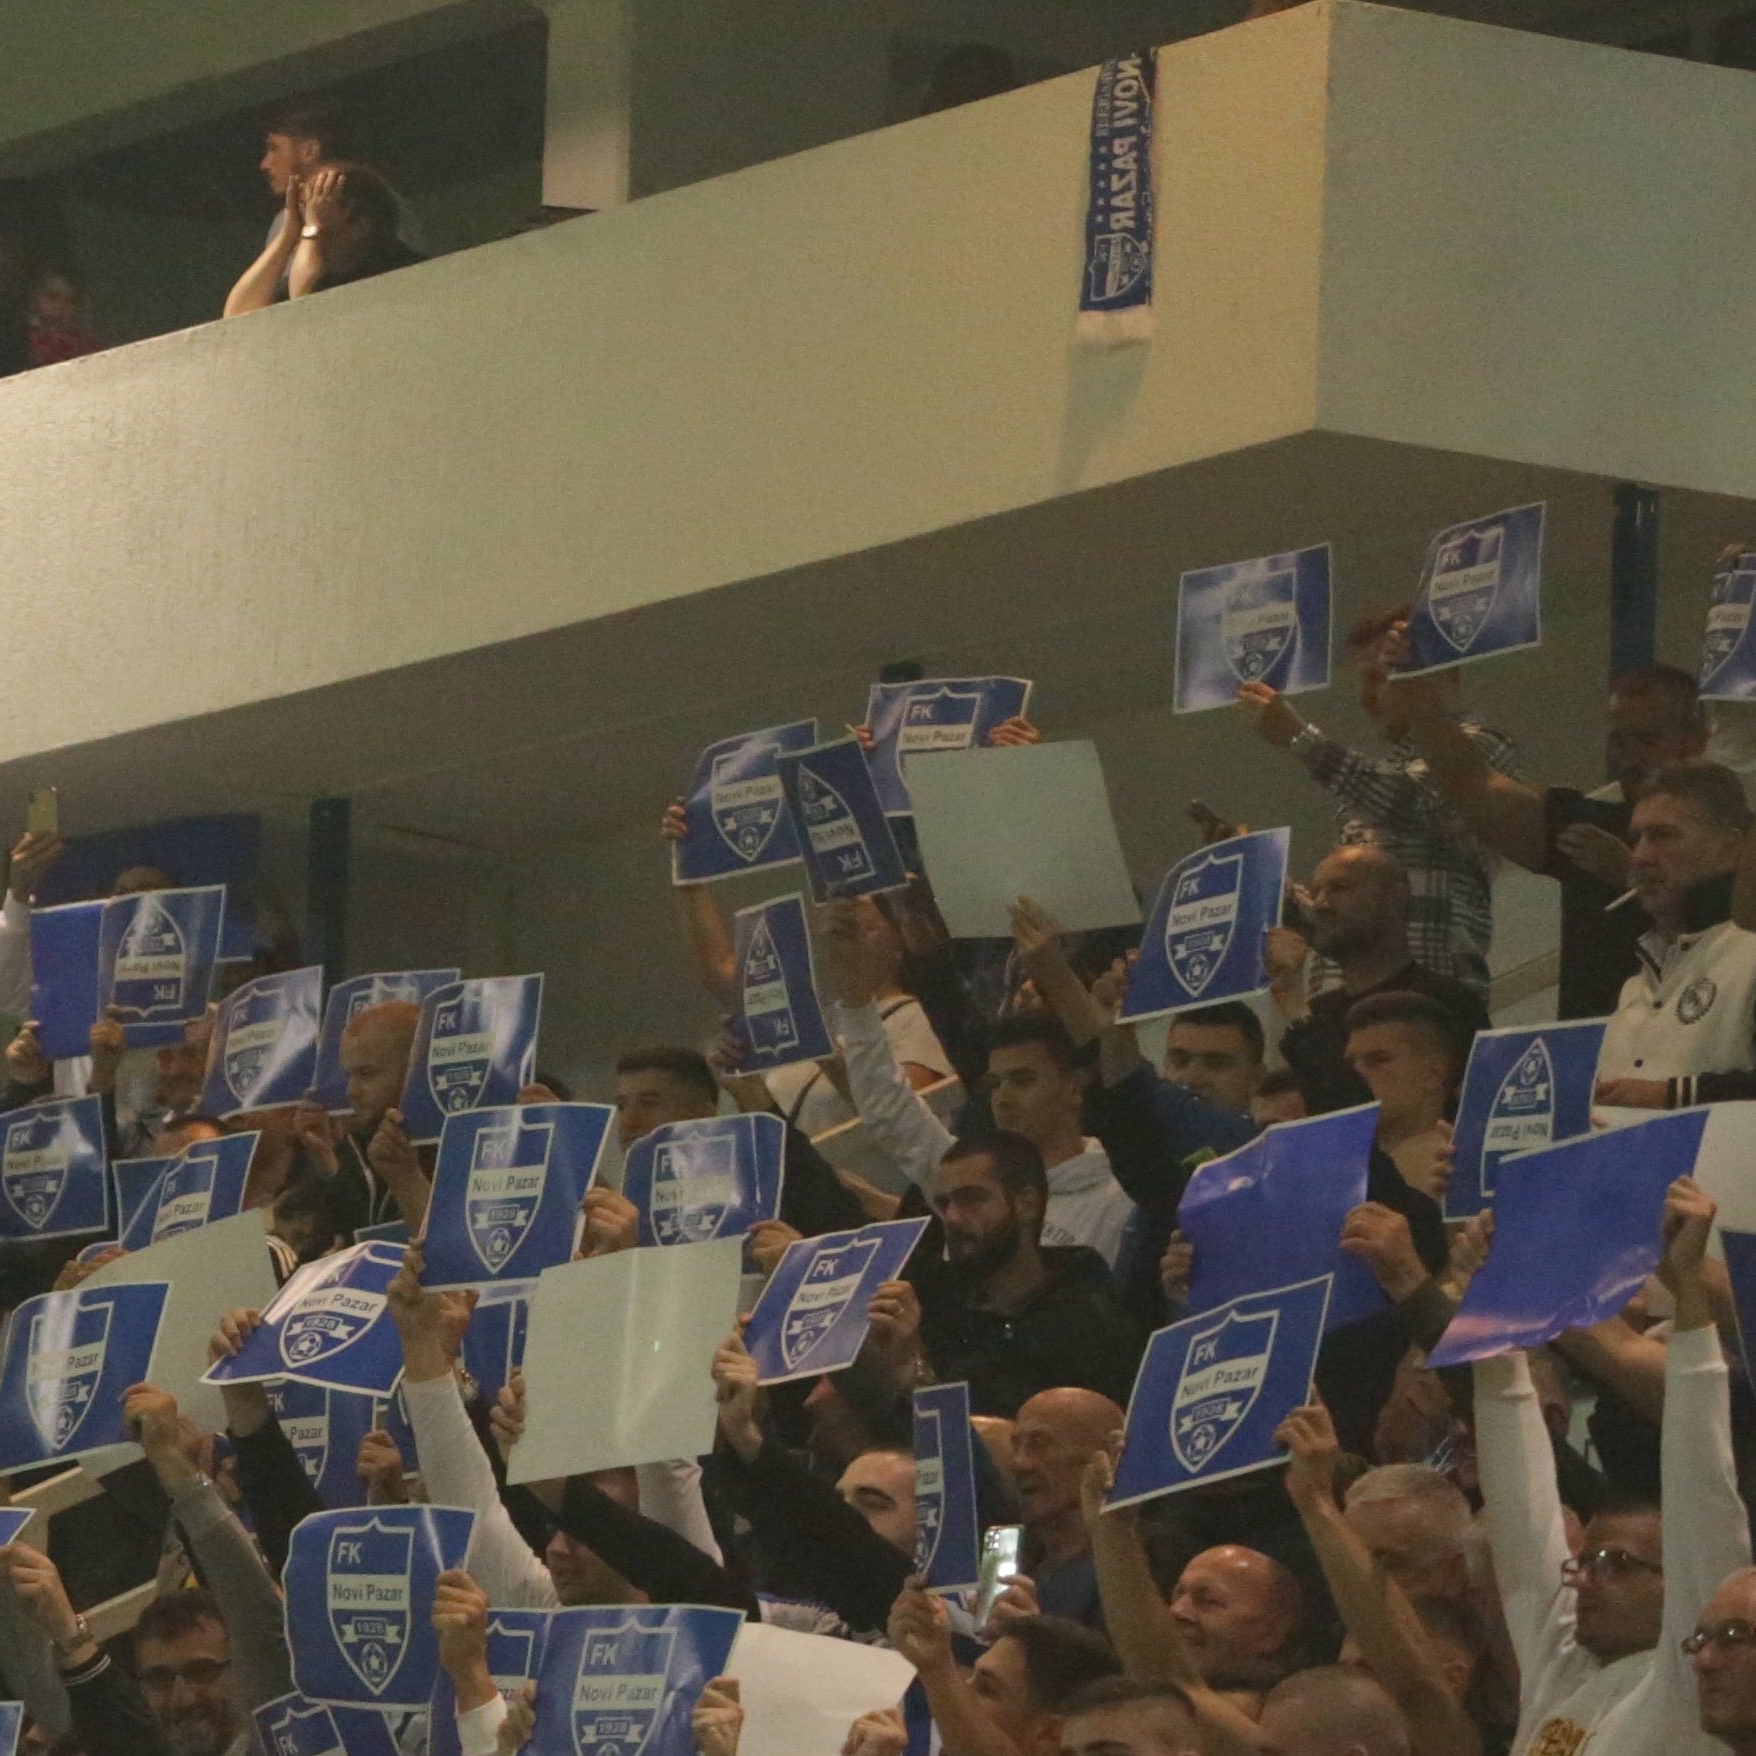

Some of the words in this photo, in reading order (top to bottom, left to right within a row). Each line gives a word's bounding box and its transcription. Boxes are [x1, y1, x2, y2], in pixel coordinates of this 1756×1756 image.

[911, 704, 933, 719] FK
[1181, 877, 1201, 898] FK
[1172, 908, 1196, 927] Novi
[1199, 902, 1233, 919] Pazar
[439, 1011, 456, 1029] FK
[432, 1042, 455, 1058] Novi
[481, 1141, 506, 1161] FK
[472, 1177, 504, 1192] Novi
[507, 1175, 541, 1190] Pazar
[813, 1258, 837, 1277] FK
[299, 1295, 327, 1310] Novi
[331, 1292, 378, 1313] Pazar
[67, 1351, 99, 1370] Pazar
[1193, 1342, 1216, 1365] FK
[1182, 1378, 1211, 1399] Novi
[1214, 1365, 1259, 1388] Pazar
[289, 1425, 323, 1441] Pazar
[337, 1542, 361, 1565] FK
[333, 1583, 361, 1601] Novi
[366, 1583, 403, 1602] Pazar
[590, 1643, 617, 1665] FK
[579, 1683, 614, 1701] Novi
[617, 1682, 657, 1700] Pazar
